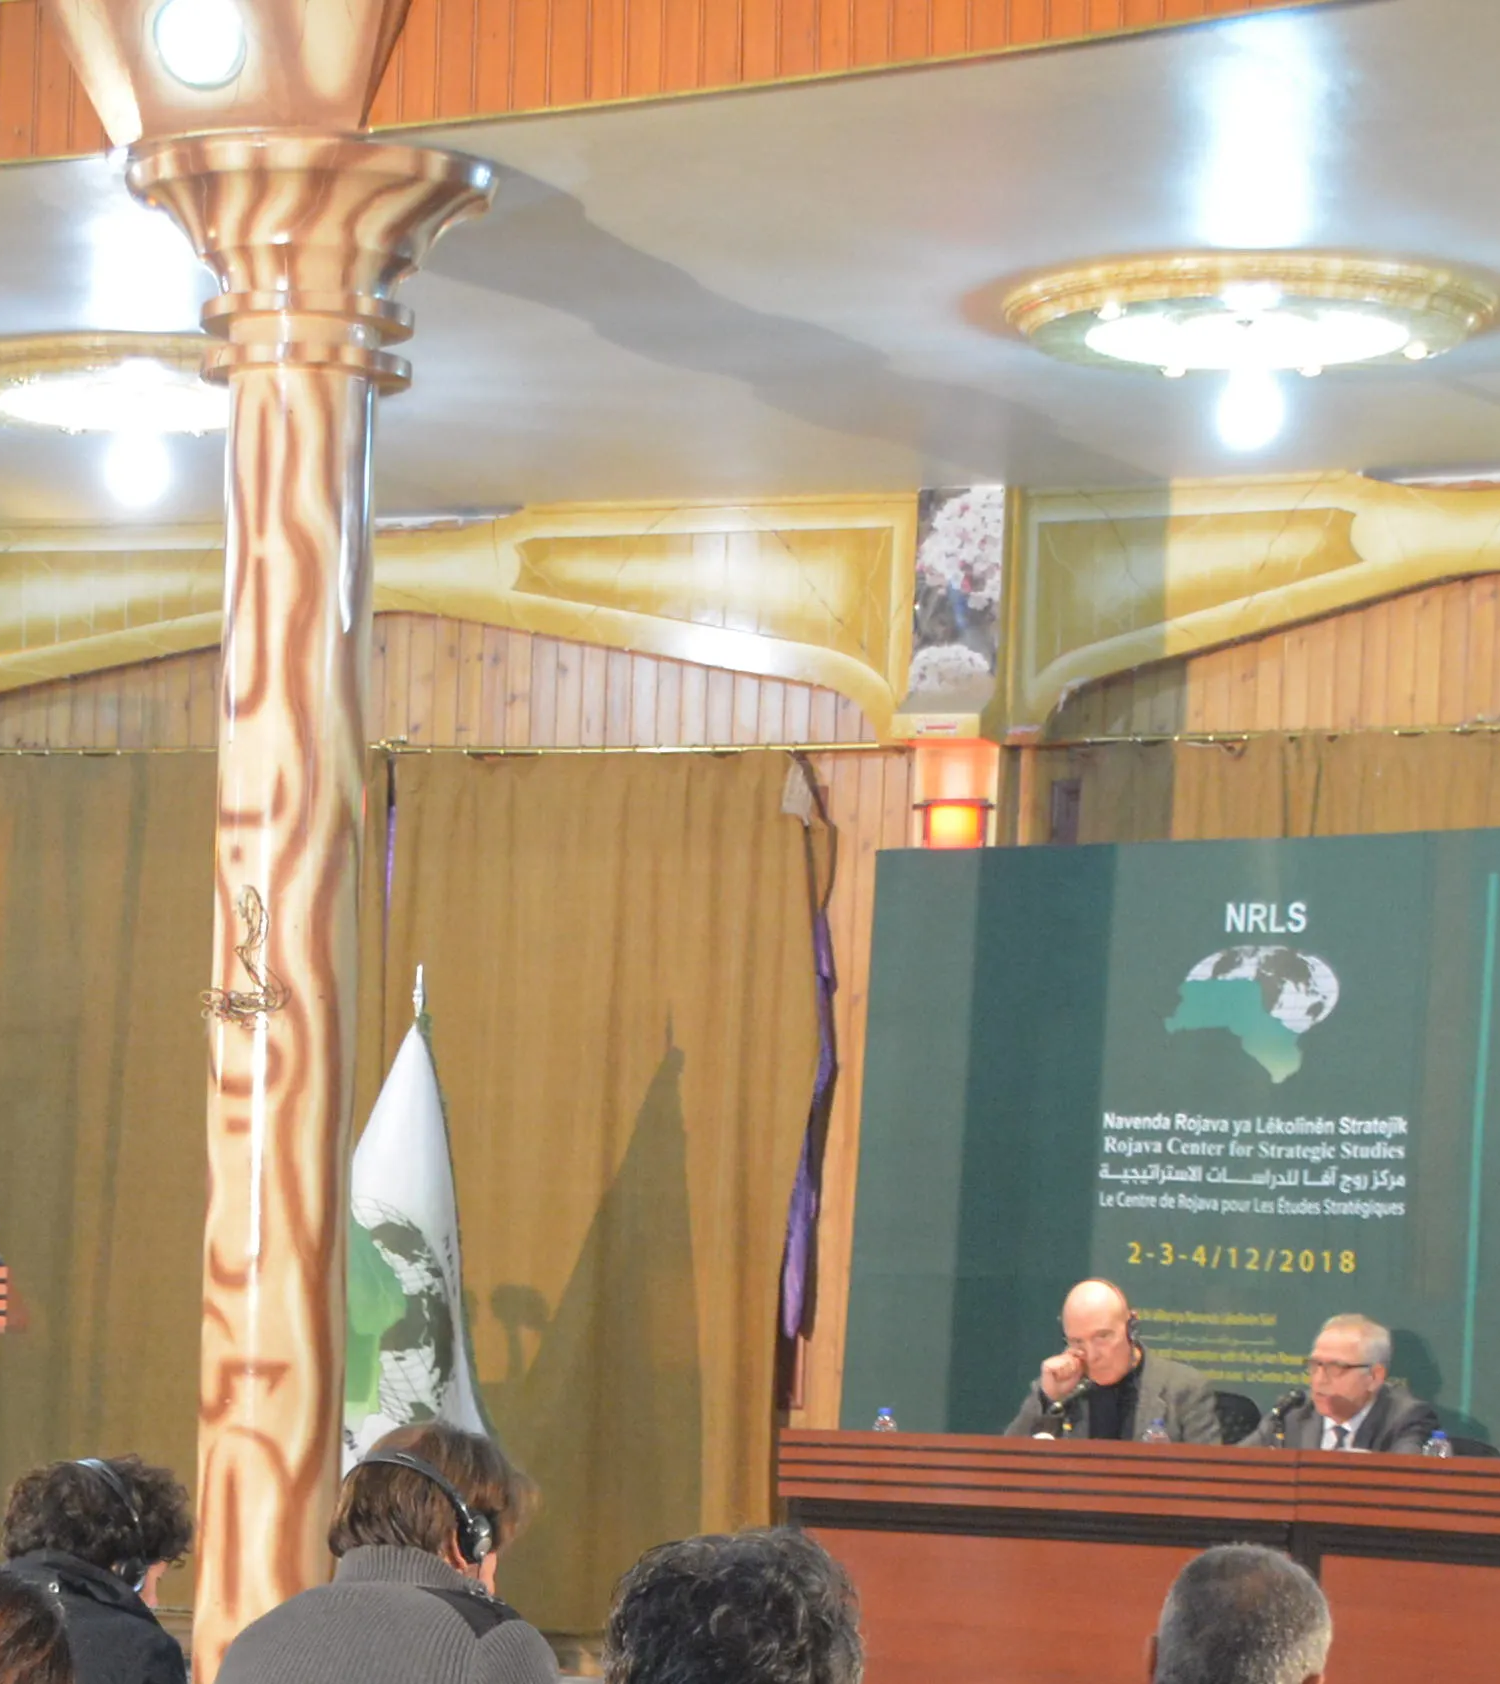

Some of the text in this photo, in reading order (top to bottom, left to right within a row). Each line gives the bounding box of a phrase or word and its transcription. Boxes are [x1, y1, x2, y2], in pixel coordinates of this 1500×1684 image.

[1224, 899, 1308, 936] NRLS
[1102, 1111, 1171, 1133] Navenda
[1174, 1112, 1230, 1137] Rojava
[1232, 1118, 1251, 1138] ya
[1103, 1136, 1406, 1164] Rojava Center for Strategic Studies
[1099, 1191, 1114, 1208] Le
[1117, 1191, 1158, 1209] Centre
[1160, 1192, 1176, 1209] de
[1178, 1193, 1220, 1214] Rojava
[1222, 1197, 1251, 1216] pour
[1253, 1196, 1275, 1215] Les
